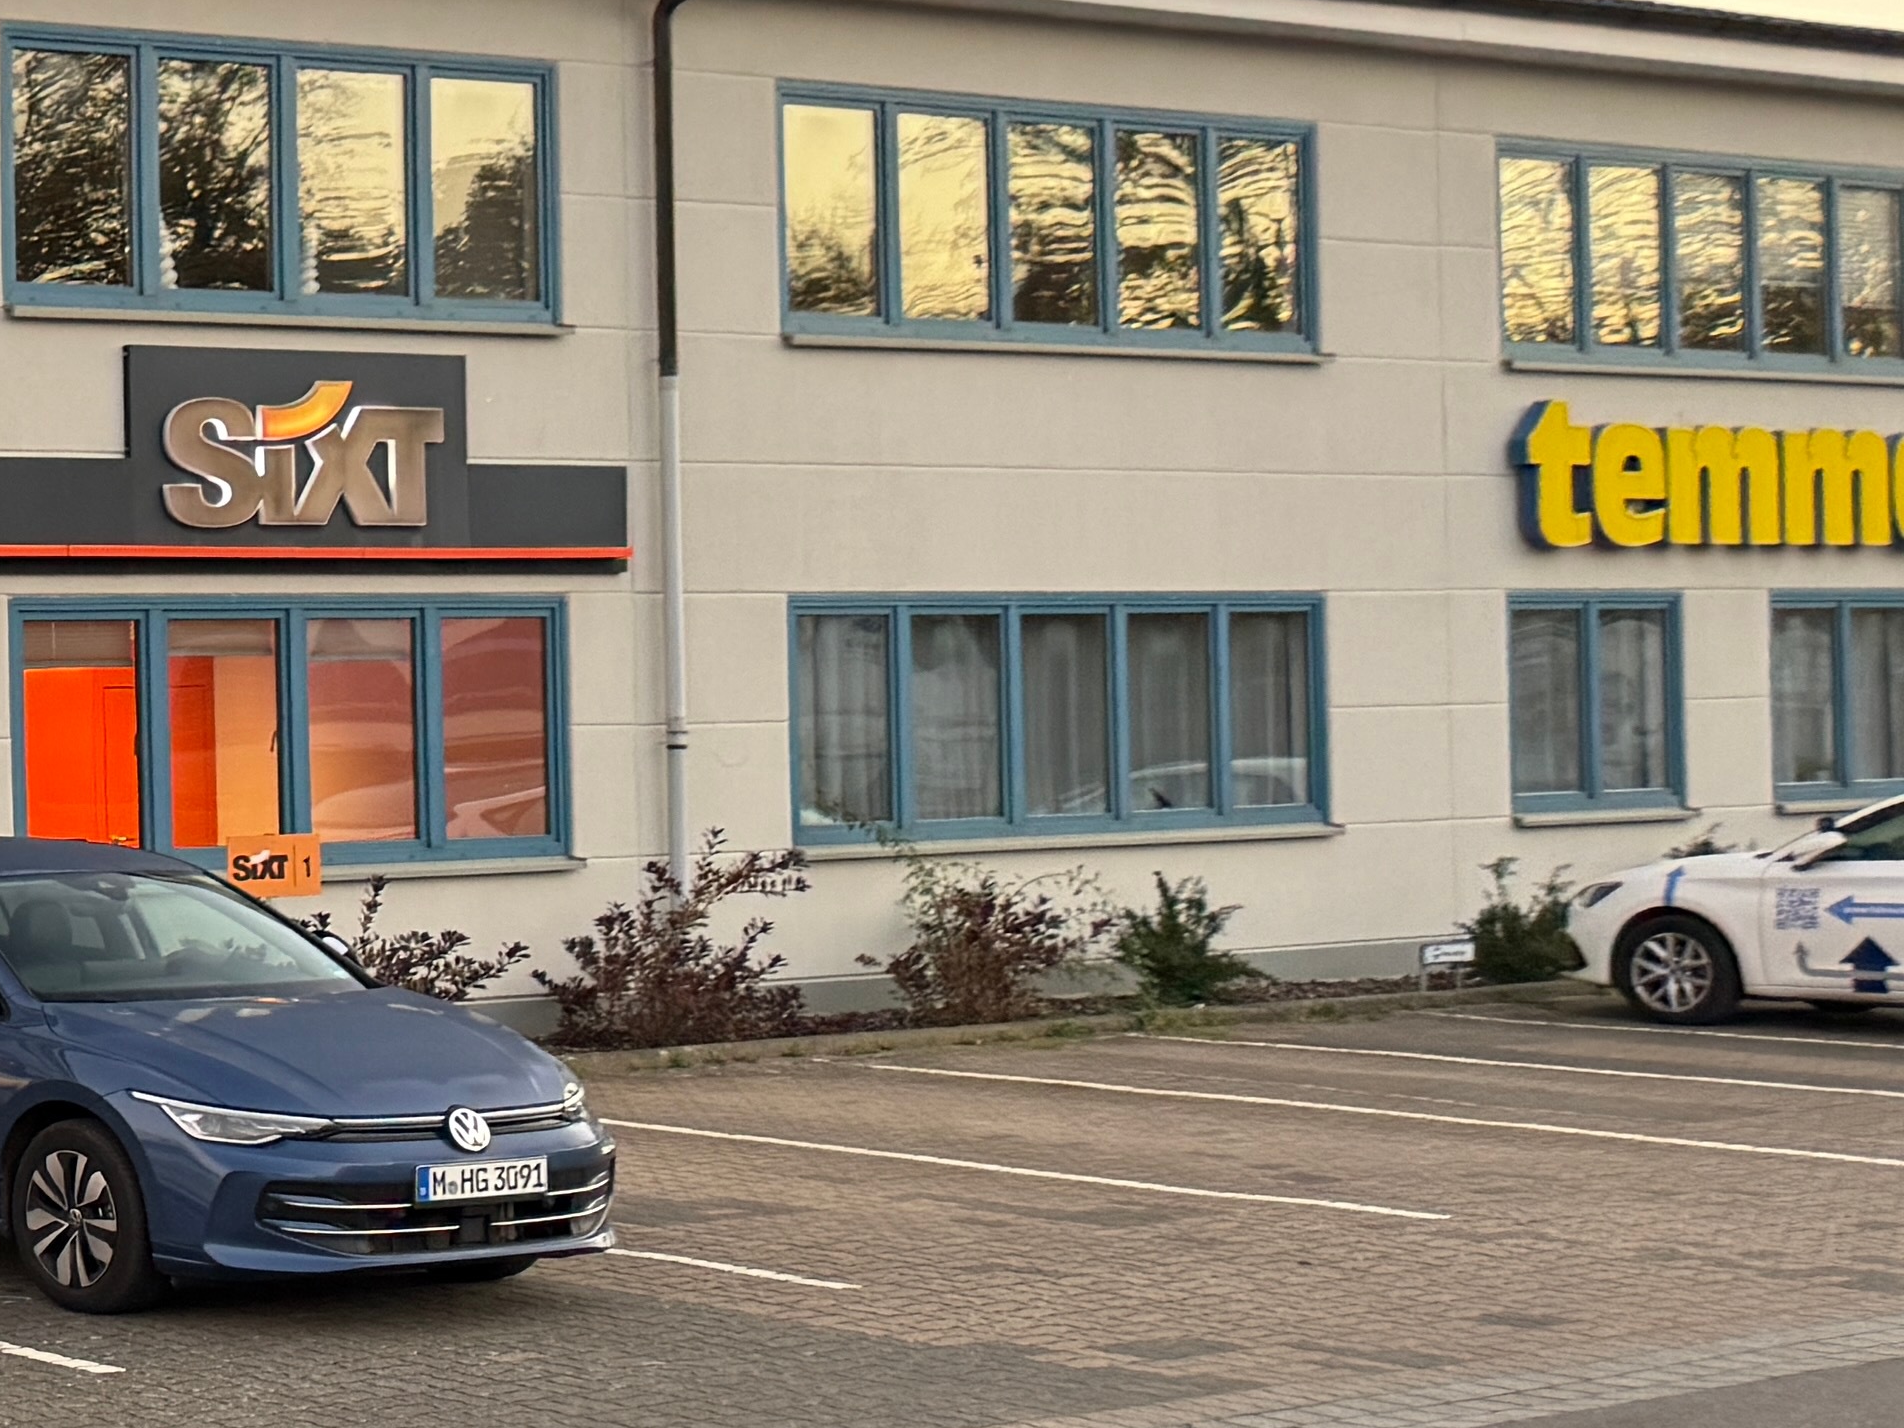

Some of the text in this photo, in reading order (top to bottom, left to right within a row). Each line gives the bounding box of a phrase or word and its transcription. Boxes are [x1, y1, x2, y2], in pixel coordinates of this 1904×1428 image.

[1508, 399, 1904, 552] temm
[303, 855, 311, 878] 1
[461, 1168, 488, 1194] HG
[494, 1163, 544, 1191] 3091
